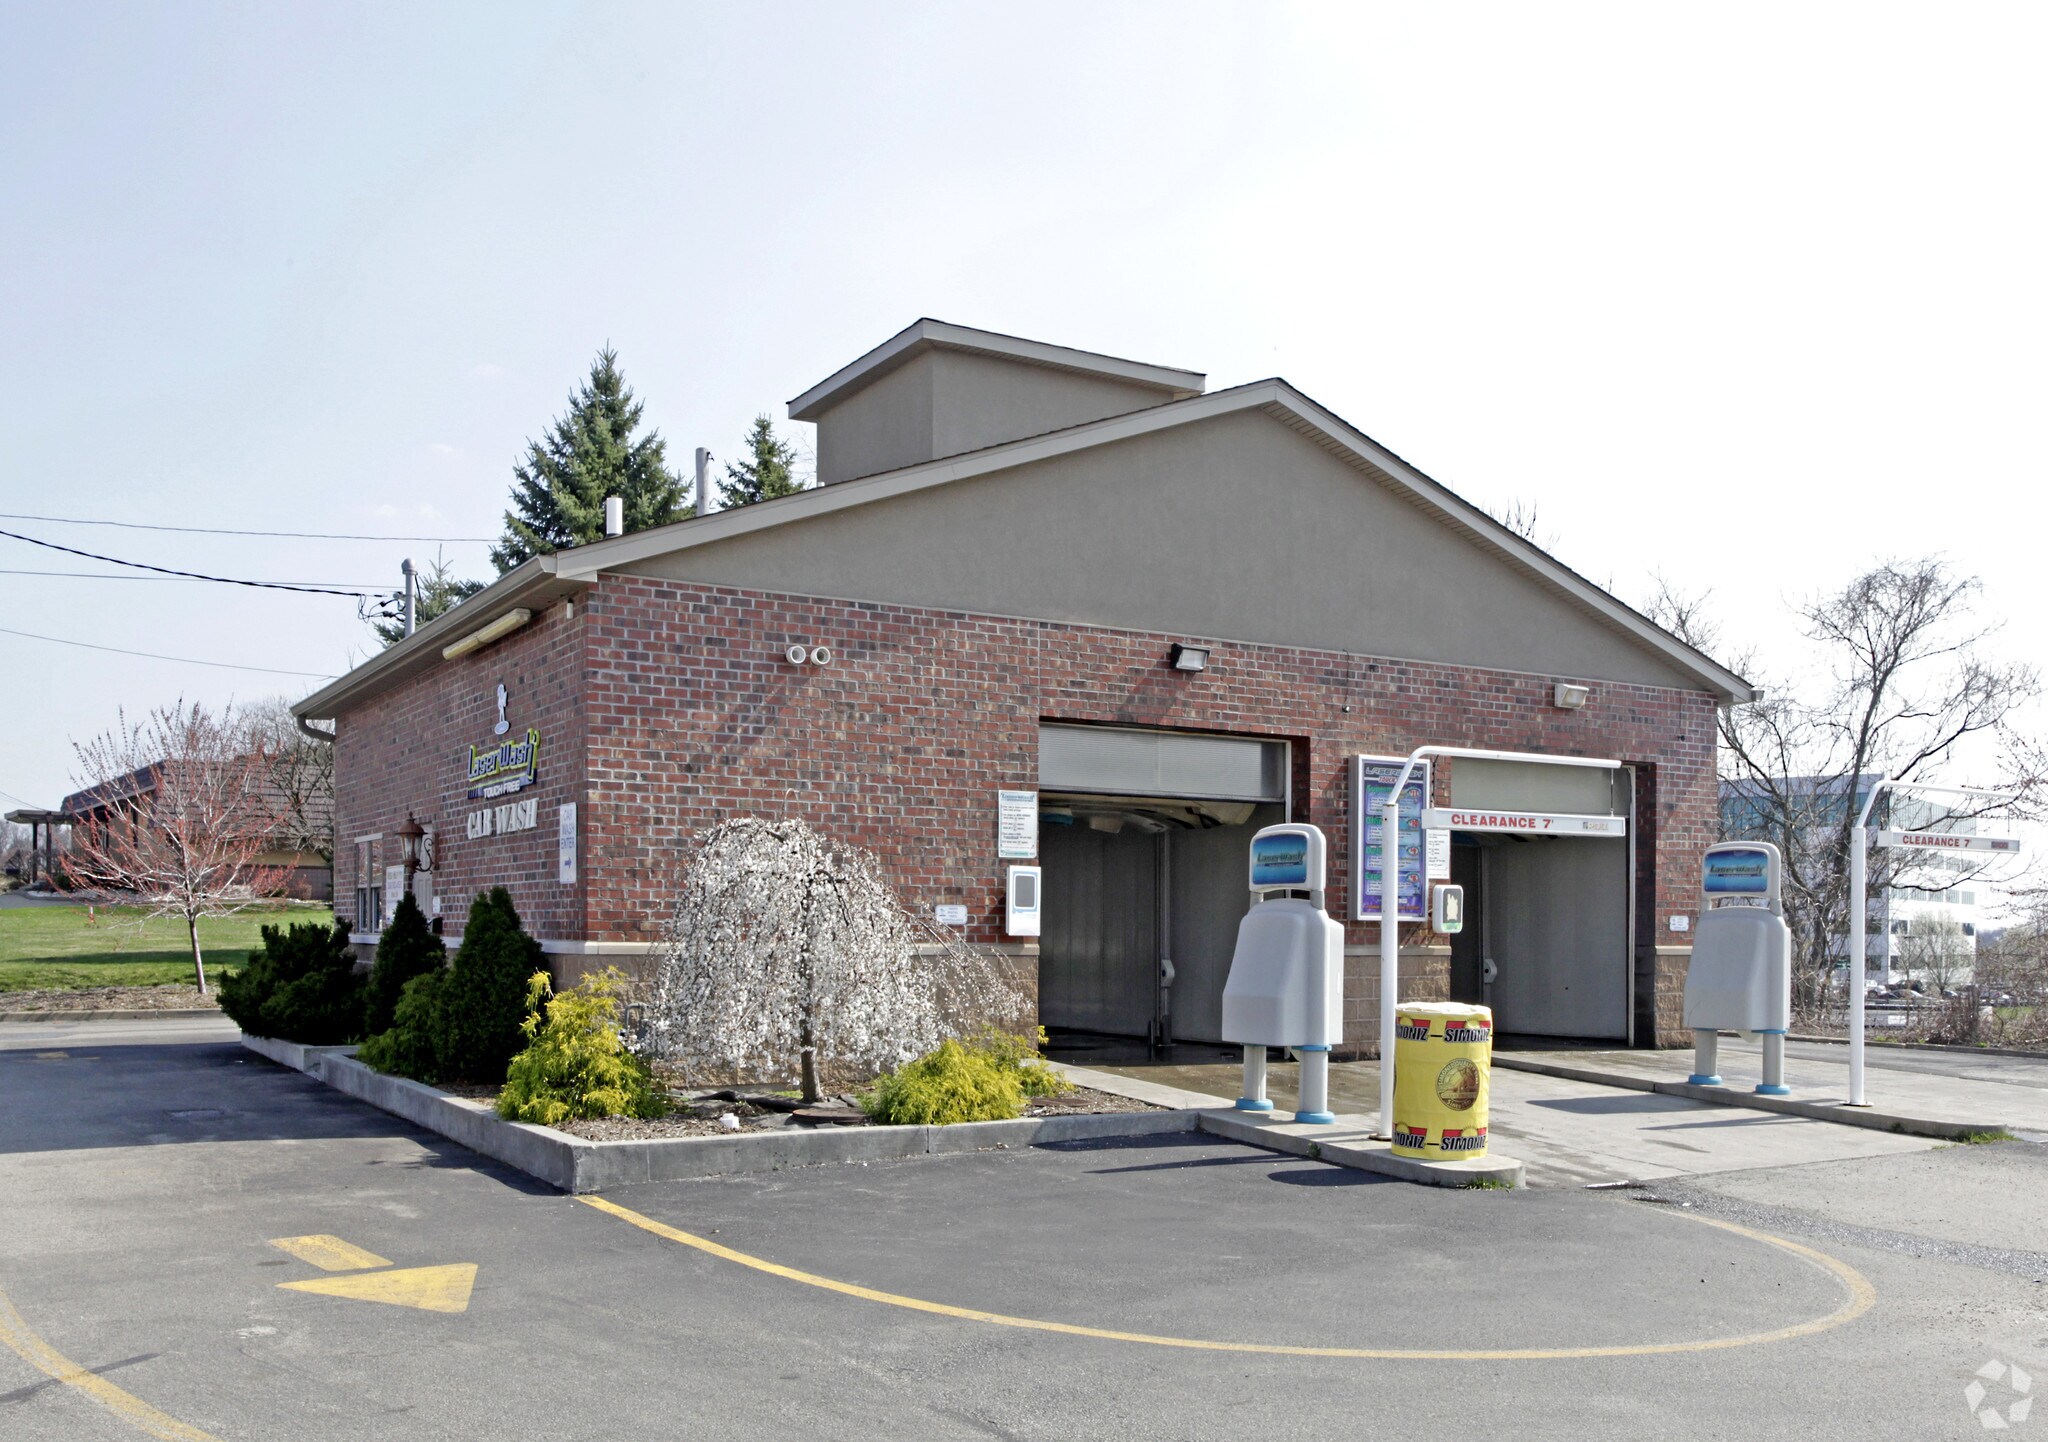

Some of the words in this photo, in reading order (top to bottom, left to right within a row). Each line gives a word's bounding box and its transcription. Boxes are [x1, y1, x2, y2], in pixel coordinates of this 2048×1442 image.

[483, 784, 503, 799] TOUCH
[503, 780, 521, 795] FREE
[467, 808, 493, 839] CAR
[495, 797, 540, 835] WASH
[1451, 813, 1536, 829] CLEARANCE
[560, 836, 575, 849] ENTER
[1902, 835, 1960, 847] CLEARANCE
[1444, 1028, 1490, 1042] SIMONIZ
[1441, 1136, 1486, 1151] SIMONIZ
